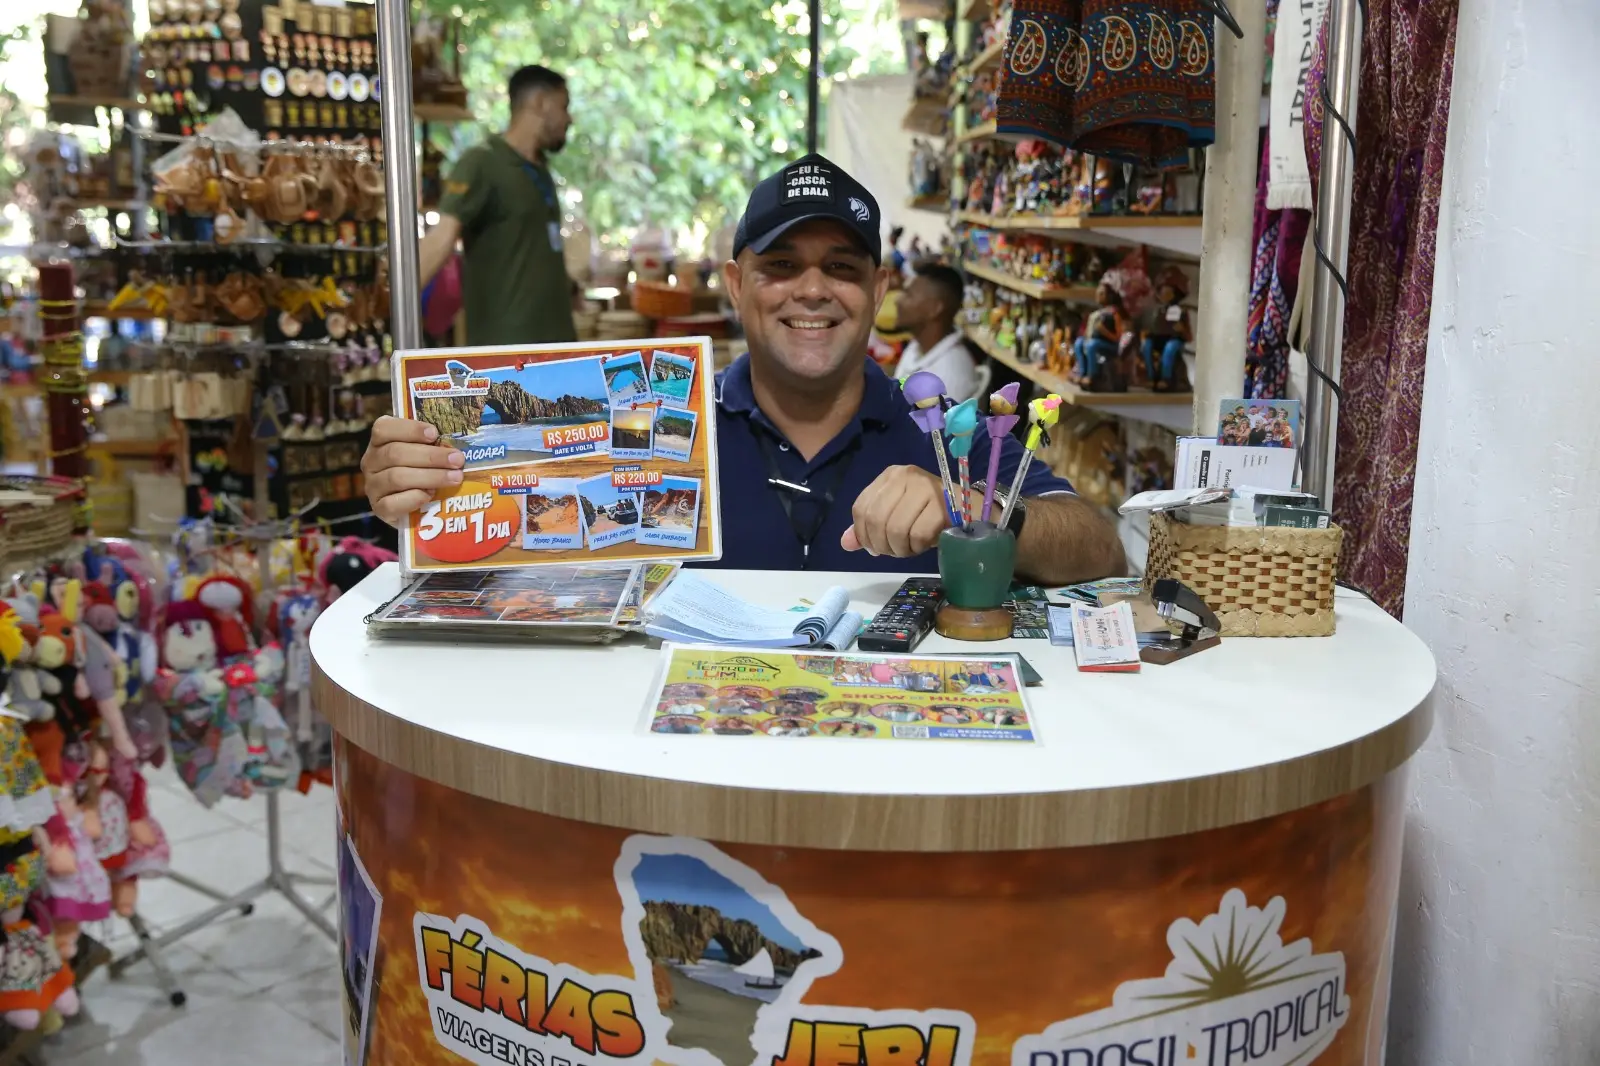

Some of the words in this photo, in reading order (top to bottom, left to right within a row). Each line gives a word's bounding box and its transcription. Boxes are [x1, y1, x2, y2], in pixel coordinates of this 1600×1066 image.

[798, 165, 811, 175] EU
[791, 175, 826, 187] CASCA
[787, 188, 801, 198] DE
[802, 187, 829, 197] BALA
[547, 431, 563, 446] R$
[565, 424, 604, 443] 250,00
[554, 447, 570, 455] BATE
[575, 443, 594, 452] VOLTA
[491, 475, 504, 487] R$
[507, 473, 537, 487] 120,00
[614, 473, 626, 485] R$
[628, 471, 659, 485] 220,00
[418, 500, 445, 541] 3
[445, 492, 493, 514] PRAIAS
[445, 515, 468, 534] EM
[470, 511, 485, 544] 1
[487, 520, 511, 540] DIA
[841, 692, 905, 701] SHOW
[929, 696, 1011, 705] HUMOR
[420, 928, 646, 1058] FÉRIAS
[1201, 976, 1345, 1066] TROPICAL
[437, 1006, 545, 1066] VIAGENS
